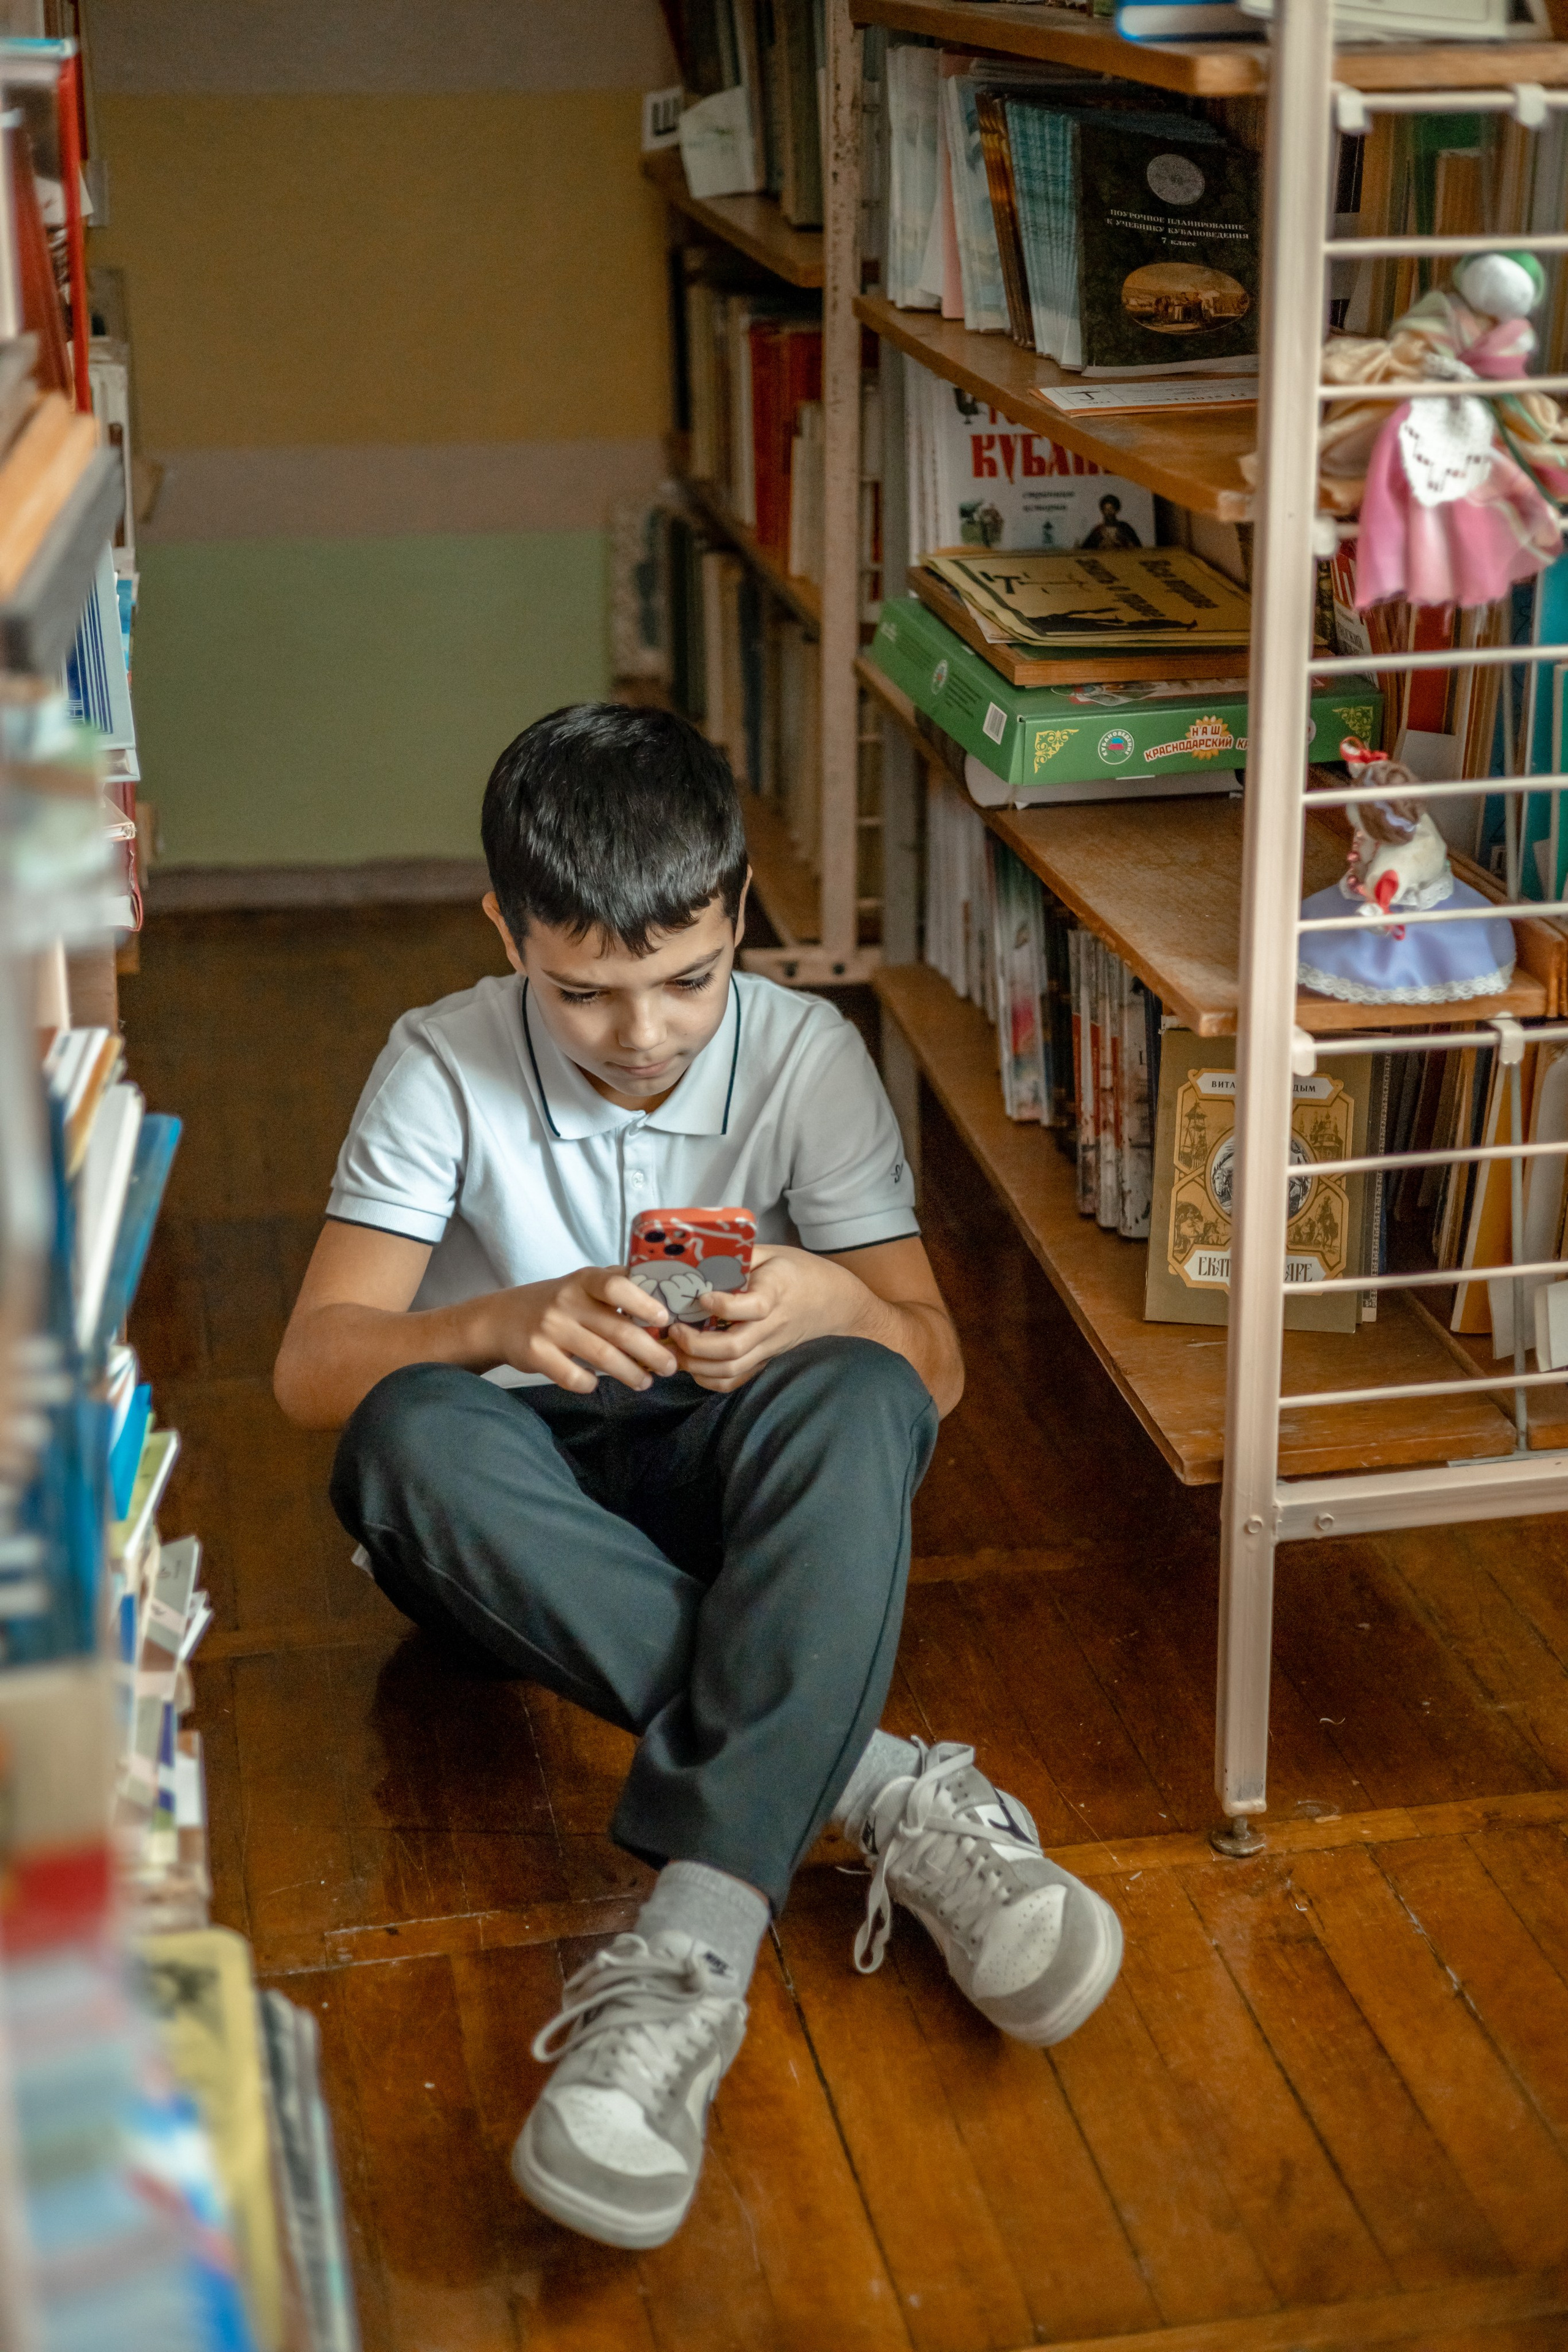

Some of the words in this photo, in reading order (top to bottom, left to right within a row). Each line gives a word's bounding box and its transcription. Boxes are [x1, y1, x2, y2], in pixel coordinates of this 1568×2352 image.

[1110, 209, 1165, 224] ПОУРОЧНОЕ
[1167, 217, 1245, 230] ПЛАНИРОВАНИЕ
[1115, 219, 1164, 233] УЧЕБНИКУ
[1167, 227, 1250, 239] КУБАНОВЕДЕНИЯ
[1191, 725, 1221, 737] НАШ
[1101, 731, 1132, 756] КУБАНОВЕДЕНИЕ
[1145, 735, 1233, 761] КРАСНОДАРСКИЙ
[1212, 1080, 1236, 1089] ВИТА
[1292, 1084, 1316, 1093] ДЫМ
